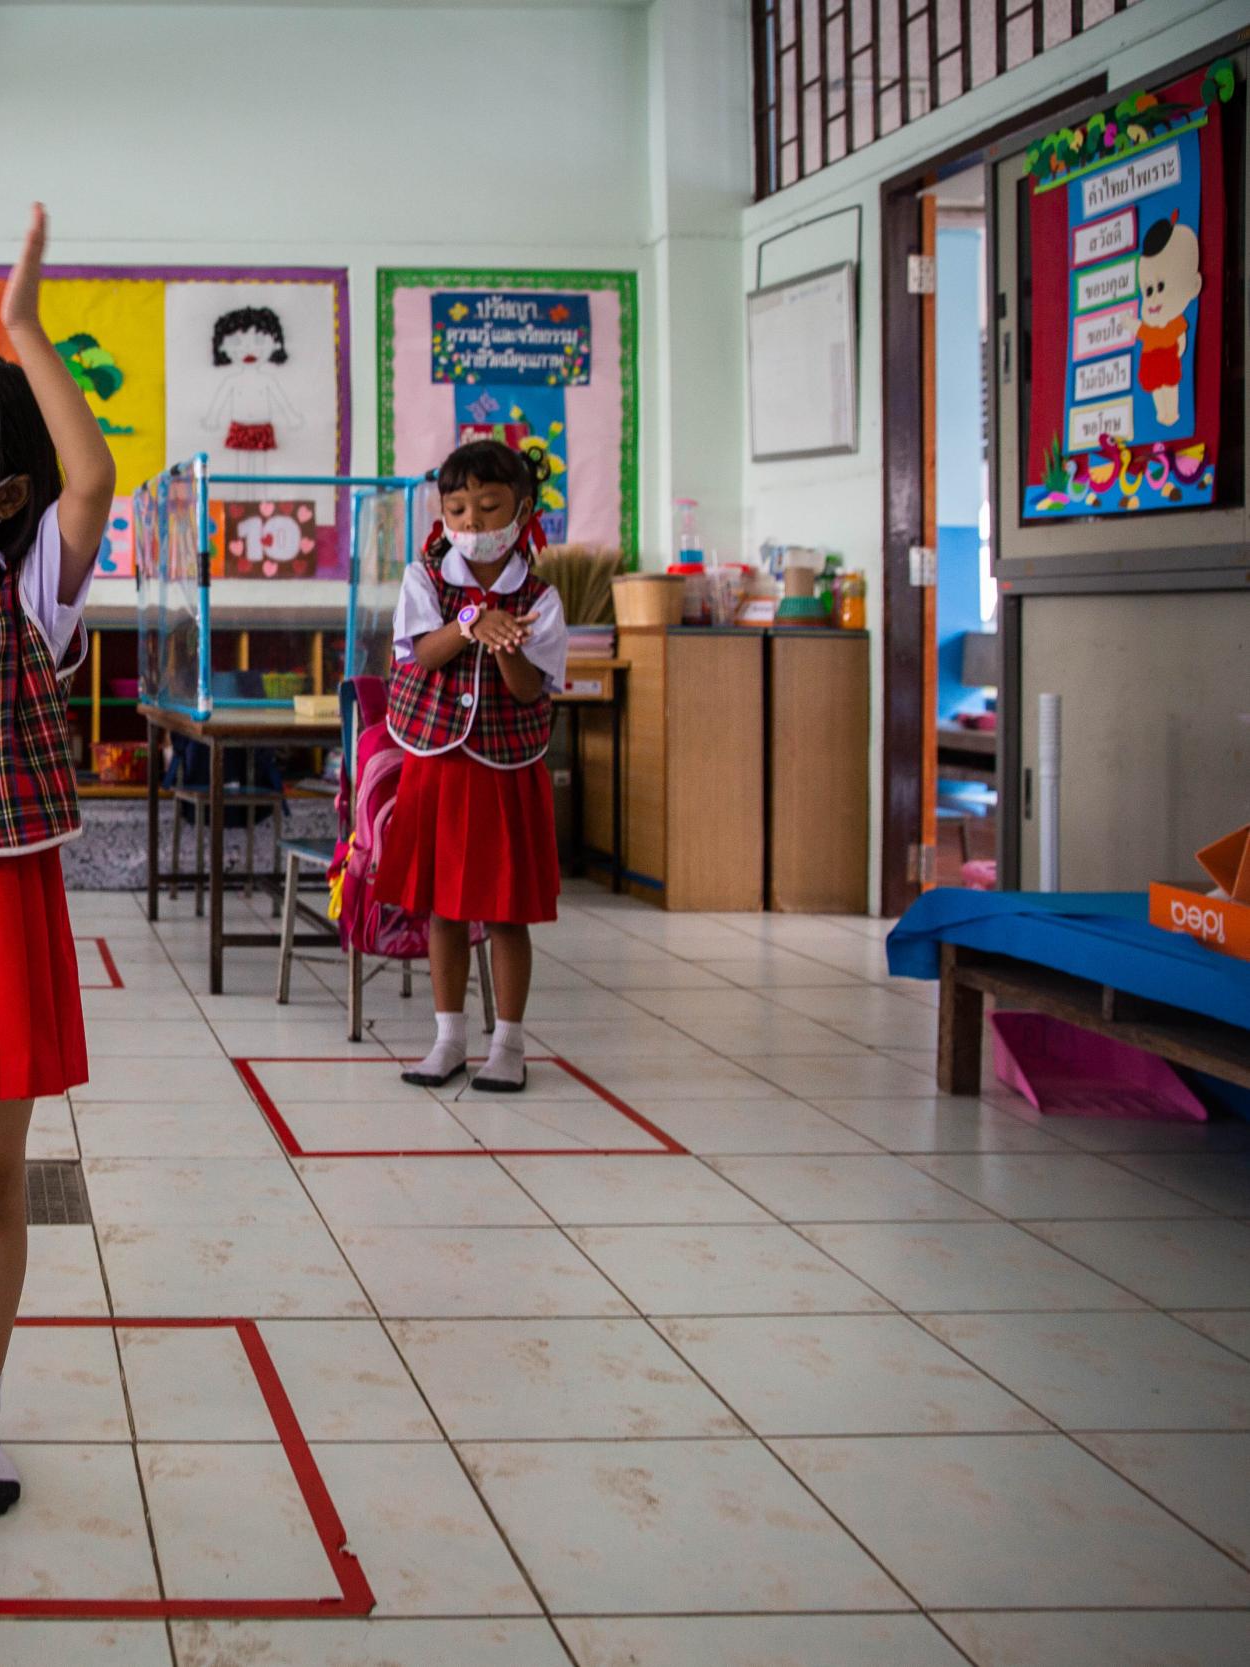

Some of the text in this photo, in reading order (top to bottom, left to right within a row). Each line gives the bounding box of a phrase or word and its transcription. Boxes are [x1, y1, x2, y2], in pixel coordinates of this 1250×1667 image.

[1088, 159, 1175, 206] คำไทยไพเราะ
[1089, 220, 1122, 251] สวัสดี
[1085, 273, 1129, 299] ขอบคุณ
[1079, 361, 1127, 390] ไม่เป็นไร
[1082, 411, 1122, 437] ขอโทษ
[236, 514, 302, 562] 10
